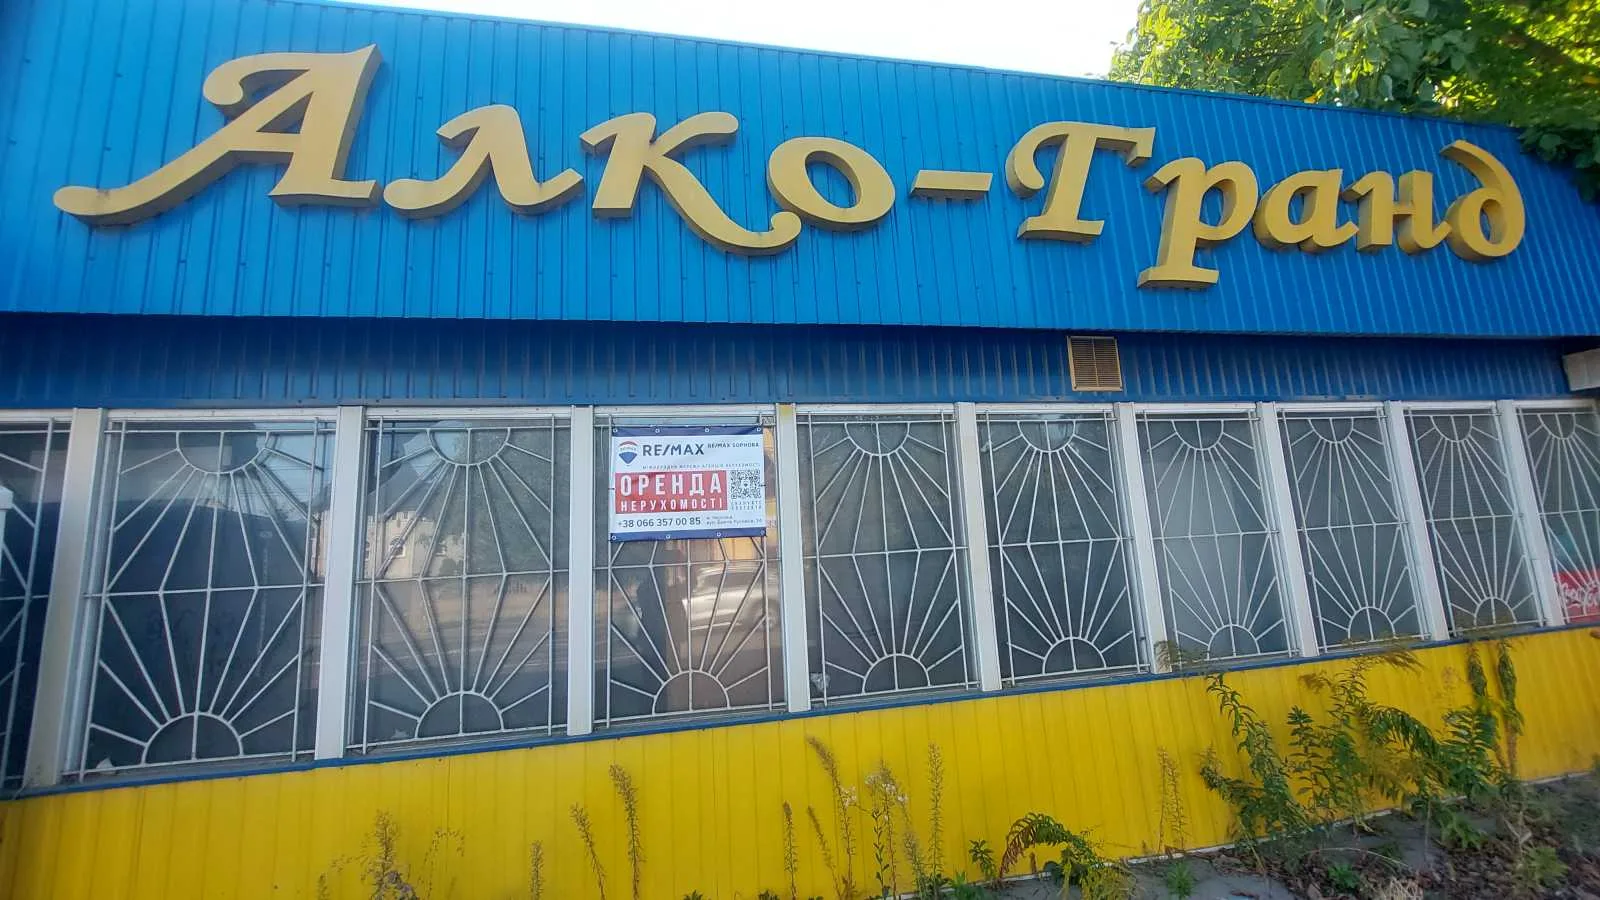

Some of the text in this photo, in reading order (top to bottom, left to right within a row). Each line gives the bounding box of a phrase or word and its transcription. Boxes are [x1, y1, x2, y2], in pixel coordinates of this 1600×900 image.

[642, 443, 704, 456] RE/MAX
[620, 473, 722, 496] ОРЕНДА
[620, 498, 723, 512] НЕРУХОМОСТІ
[618, 519, 635, 528] +38
[636, 518, 655, 527] 066
[656, 517, 674, 527] 357
[675, 517, 687, 526] 00
[689, 516, 701, 525] 85
